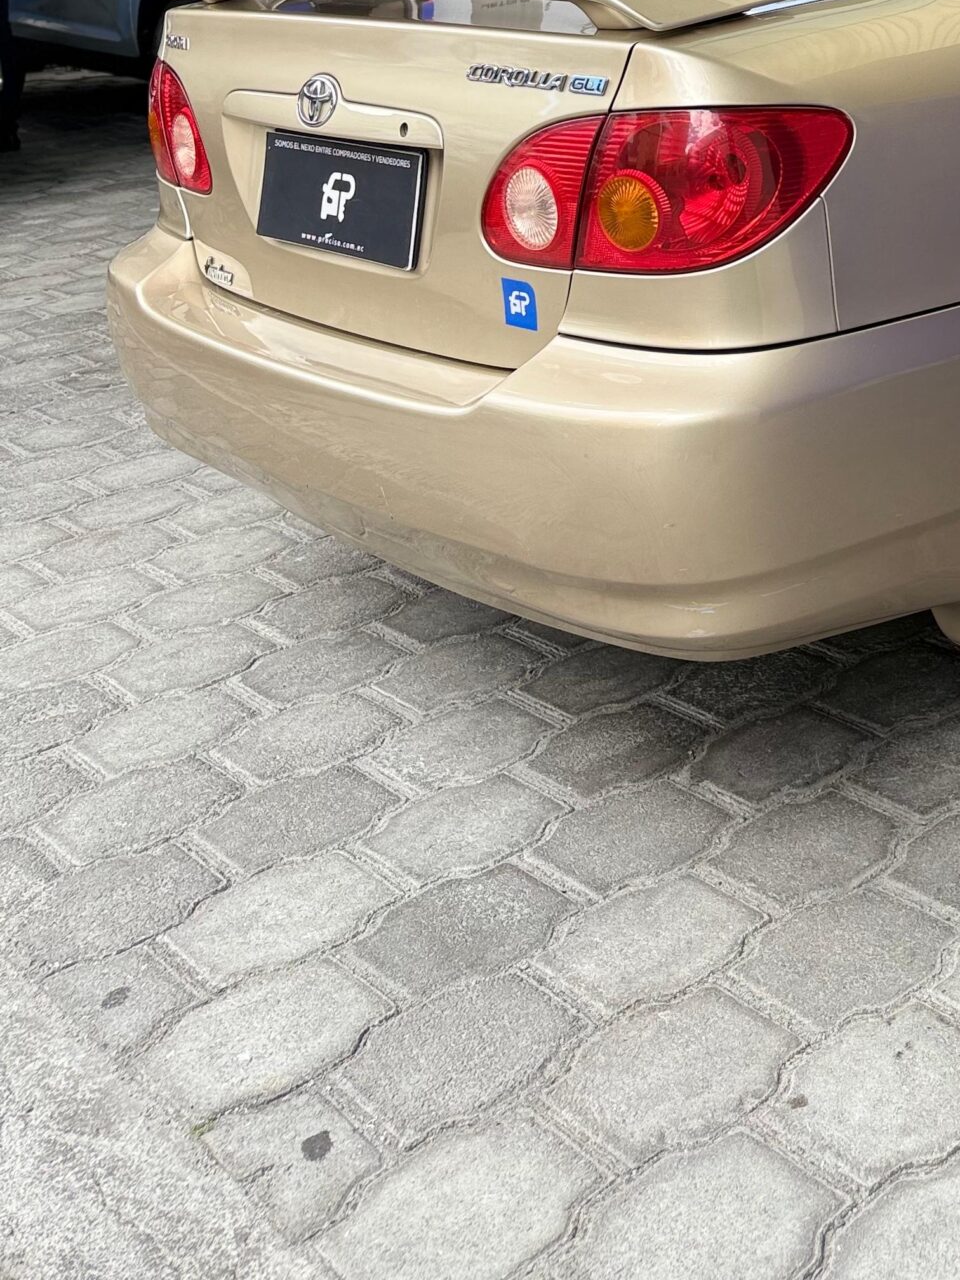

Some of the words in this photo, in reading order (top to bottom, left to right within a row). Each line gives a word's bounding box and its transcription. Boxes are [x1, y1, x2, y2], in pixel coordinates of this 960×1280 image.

[466, 63, 569, 93] COROLLA
[274, 139, 293, 149] SOMOS
[293, 142, 301, 150] EL
[300, 143, 315, 152] NEXO
[315, 146, 332, 155] ENTRE
[332, 148, 372, 162] COMPRADORES
[375, 155, 411, 168] VENDEDORES
[301, 232, 365, 252] www.preciso.com.ec
